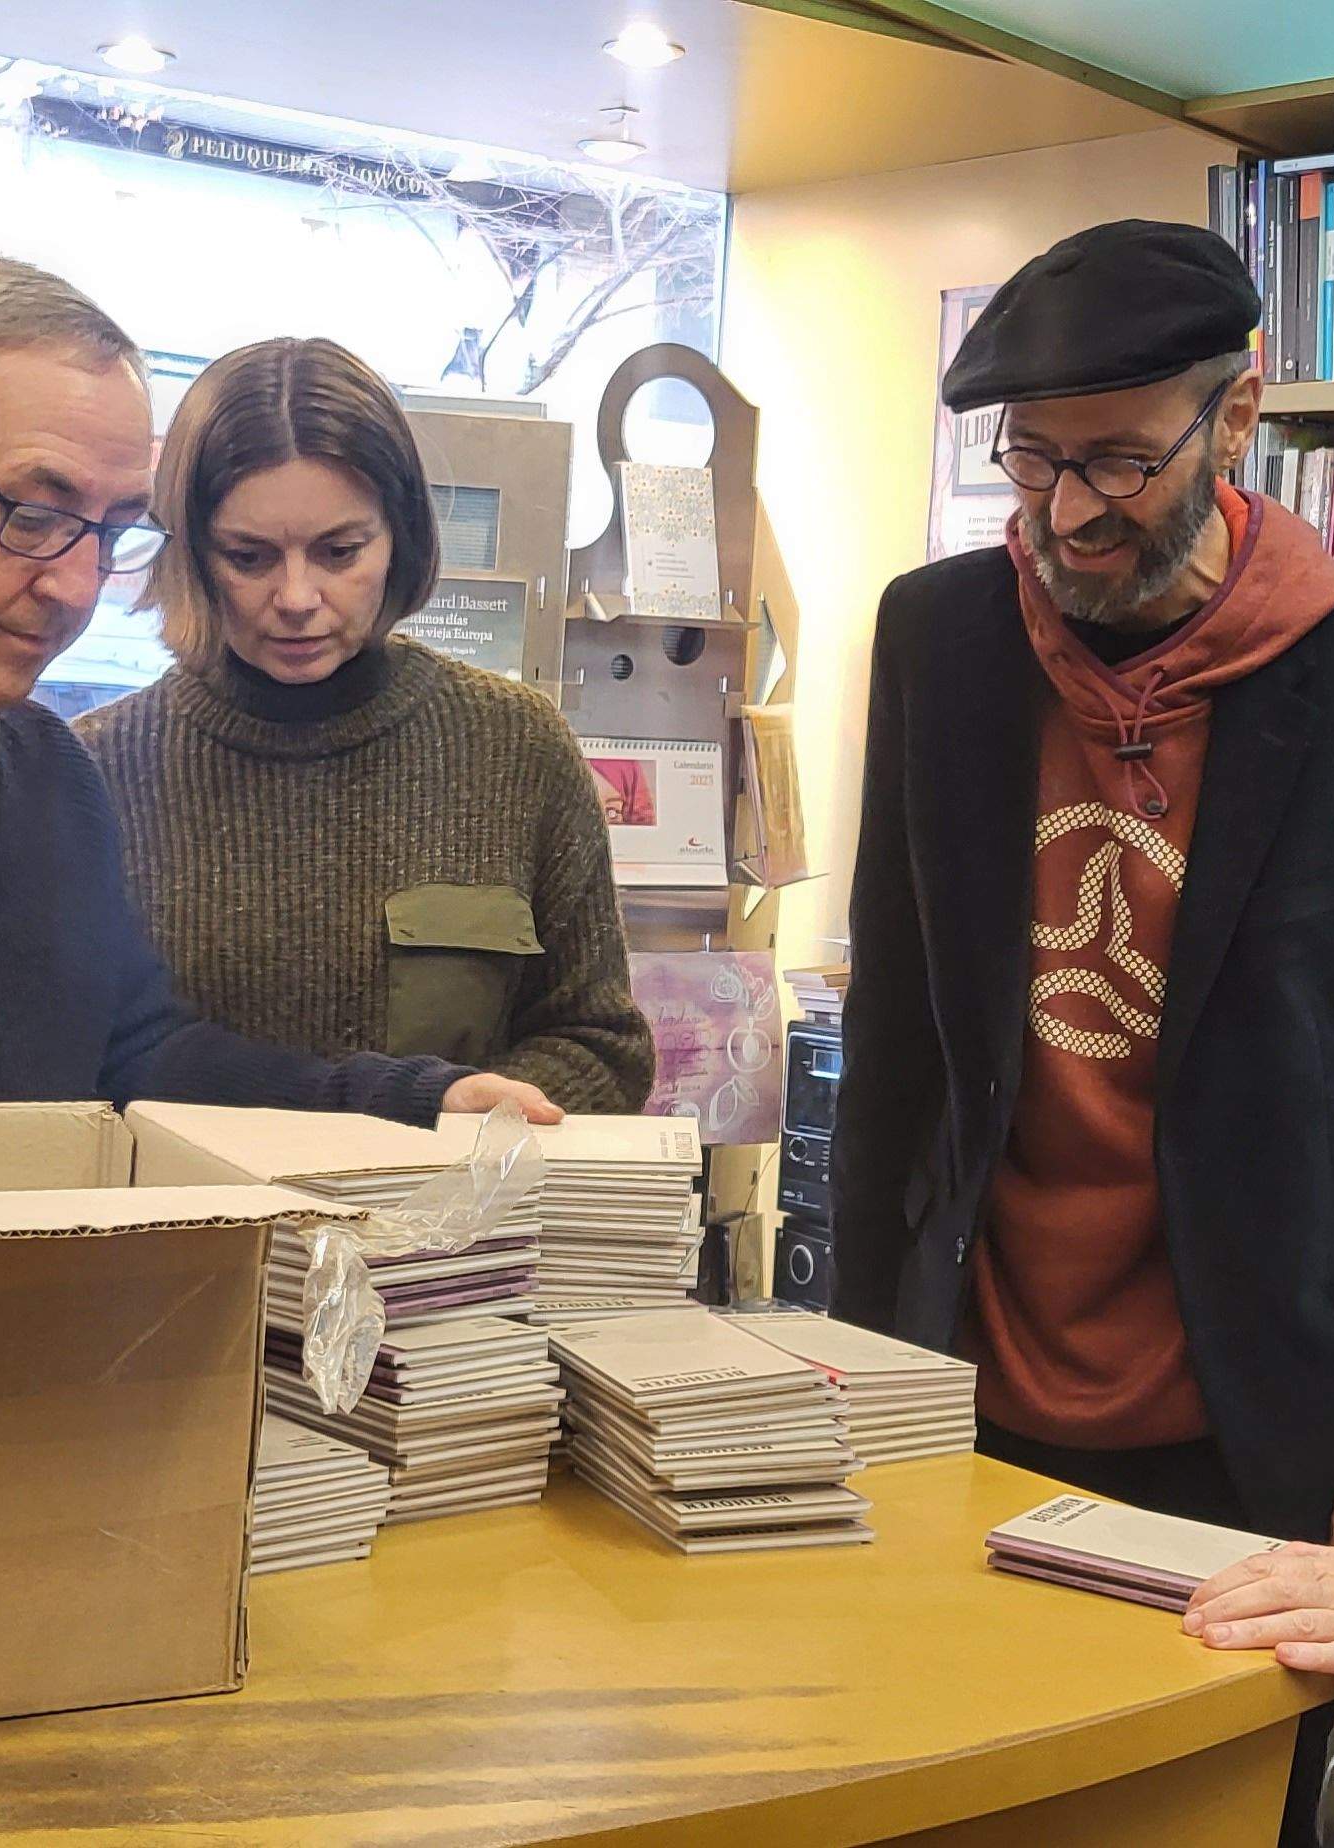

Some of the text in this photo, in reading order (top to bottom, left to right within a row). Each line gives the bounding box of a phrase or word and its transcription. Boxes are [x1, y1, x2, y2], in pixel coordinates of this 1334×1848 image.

[460, 596, 508, 612] Bassett
[638, 1369, 748, 1390] BEETHOVEN
[682, 1494, 793, 1511] BEETHOVEN
[1027, 1498, 1085, 1522] BEETHOVEN
